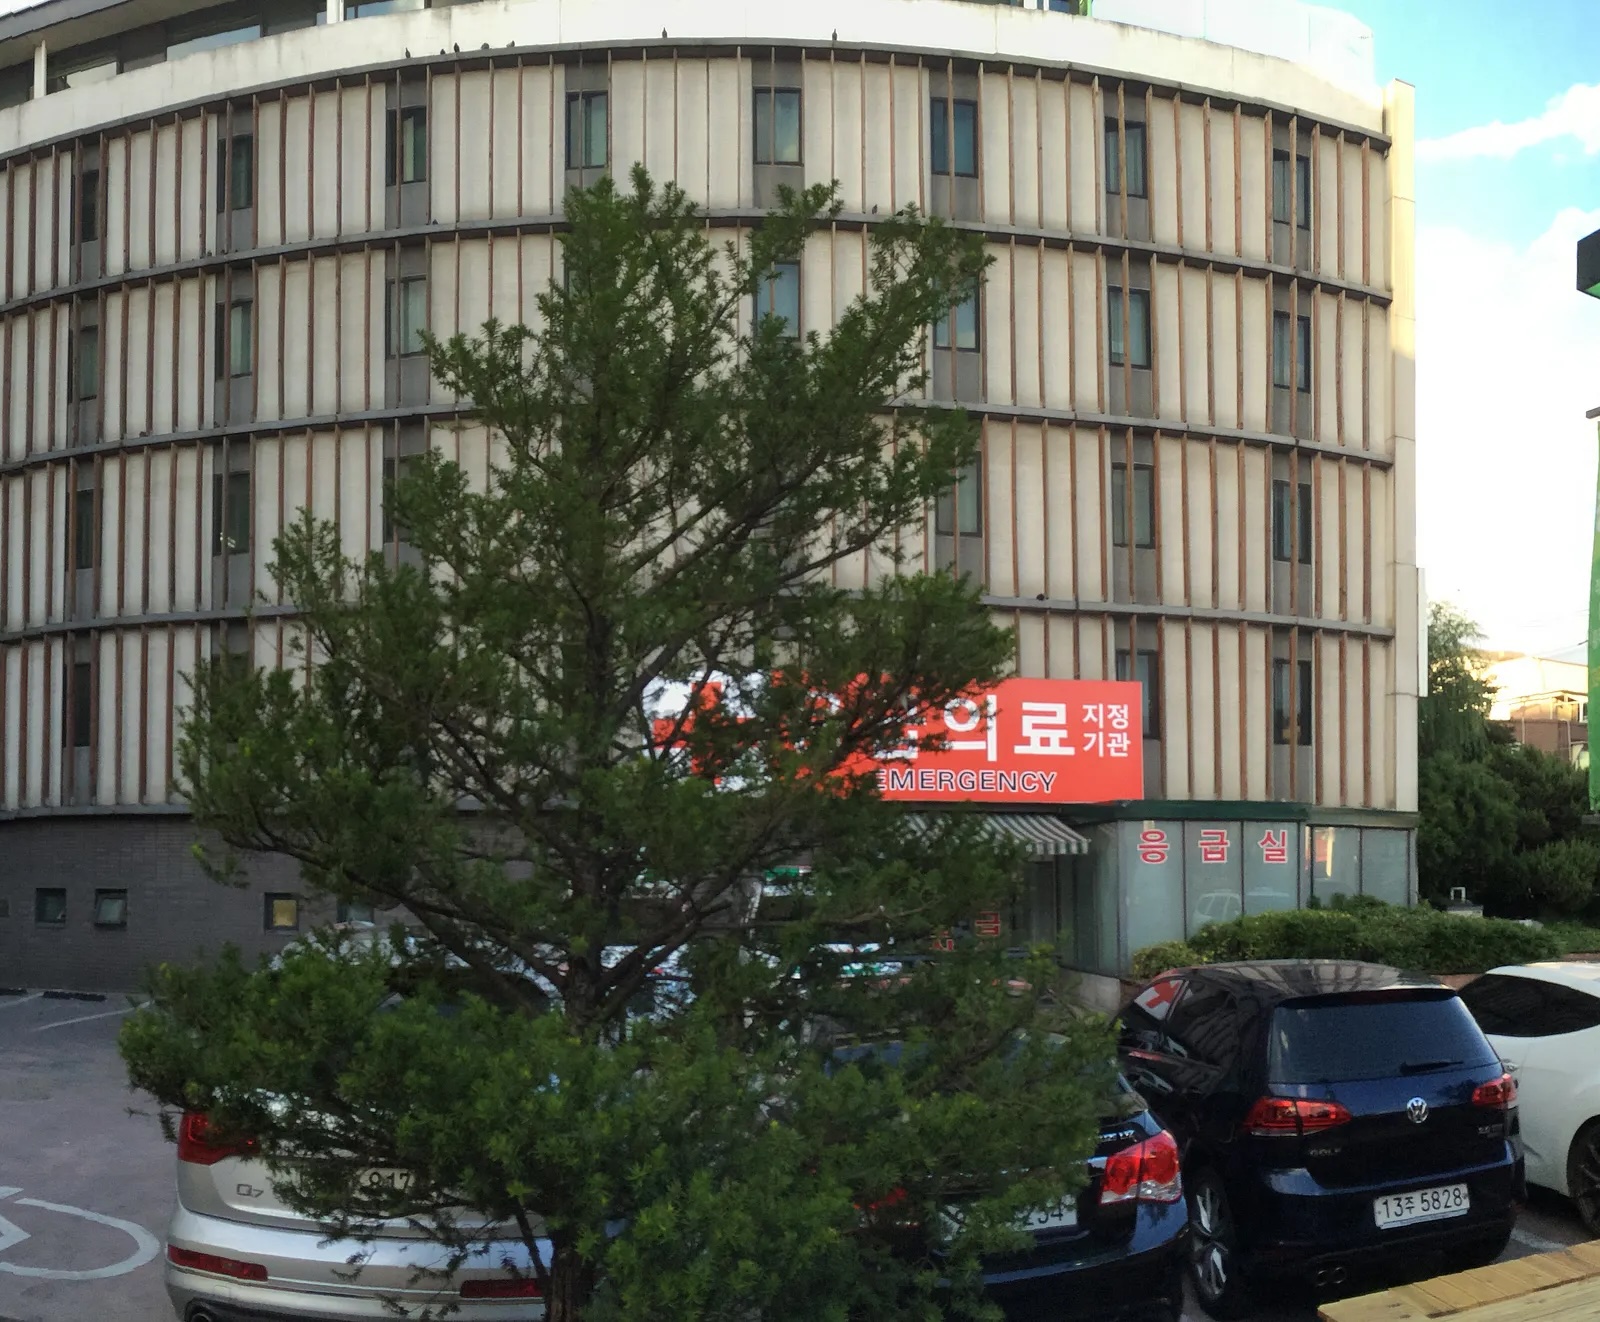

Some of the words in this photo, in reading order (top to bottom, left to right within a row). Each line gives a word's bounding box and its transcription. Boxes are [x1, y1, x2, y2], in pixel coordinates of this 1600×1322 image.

[1082, 703, 1130, 730] 지정
[1082, 731, 1130, 759] 기관
[876, 769, 1058, 794] EMERGENCY
[1137, 828, 1289, 865] 응급실
[1420, 1187, 1463, 1212] 5828
